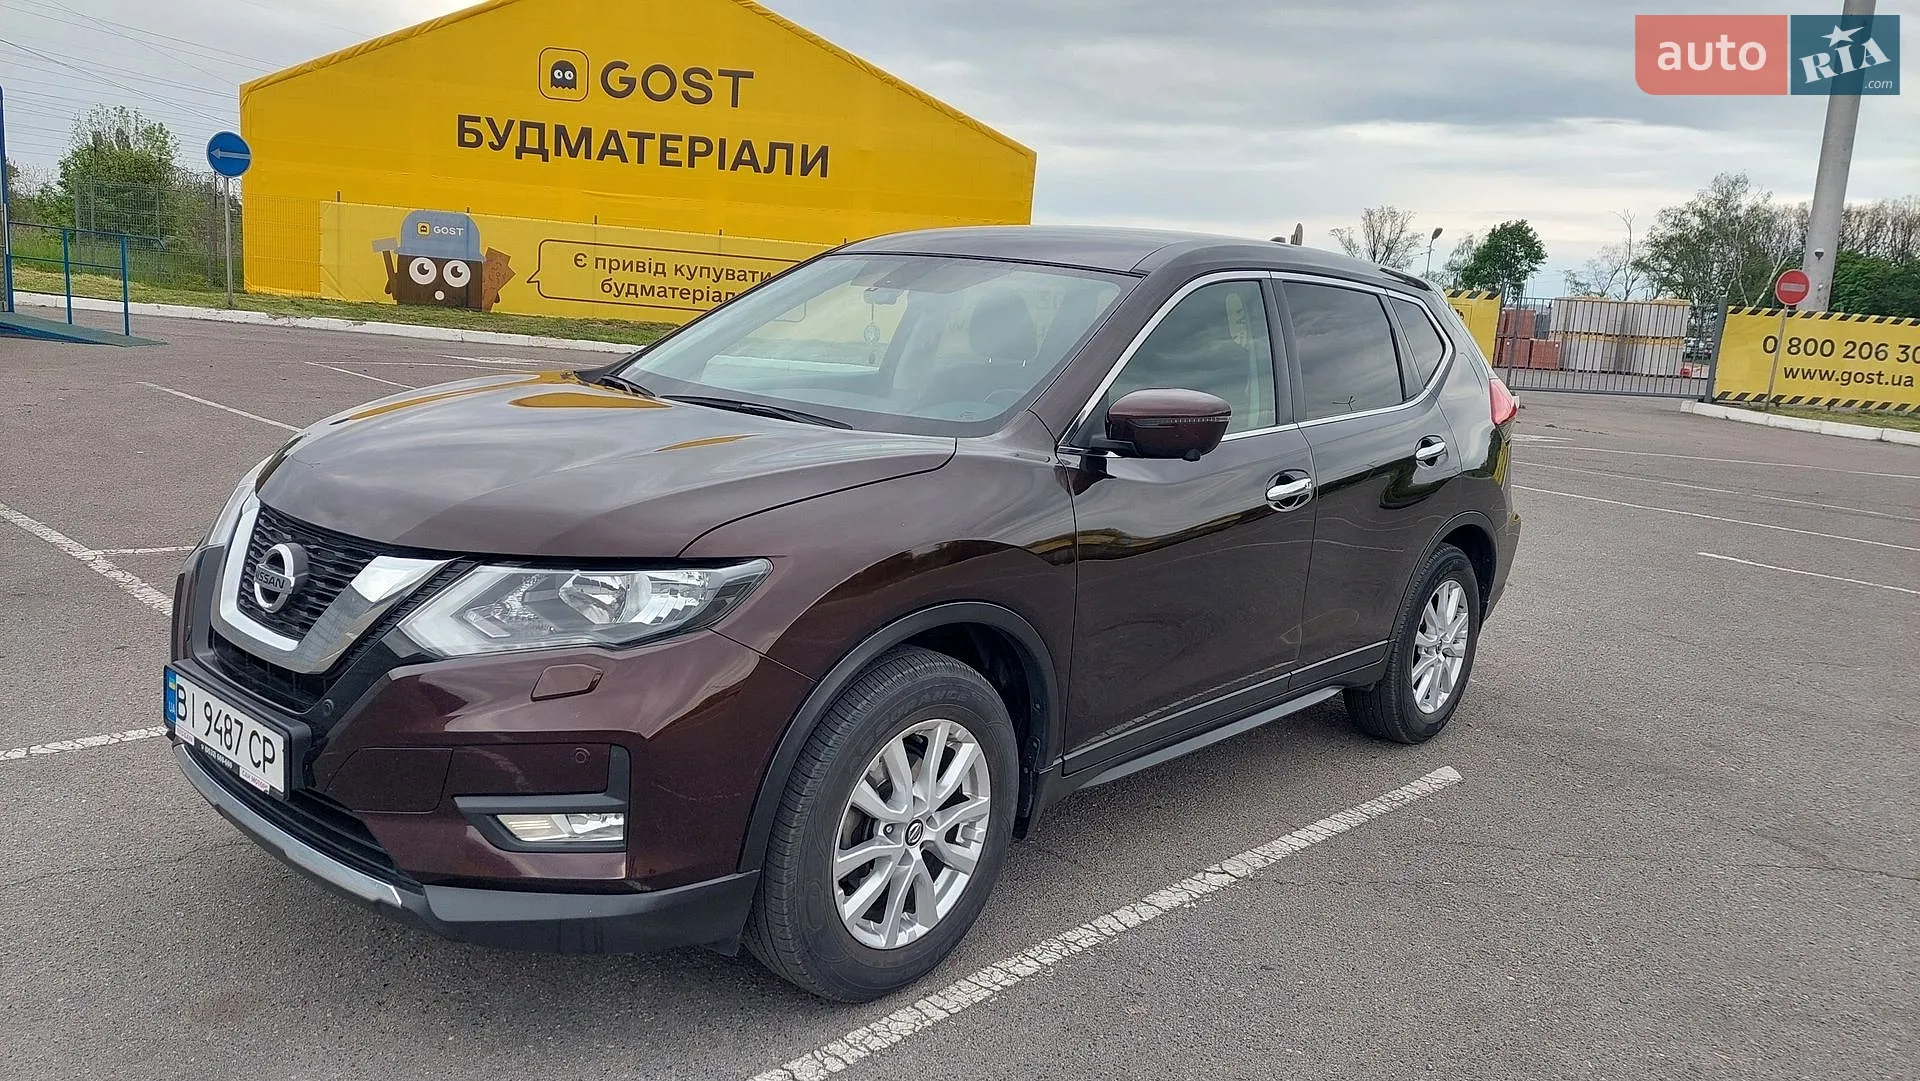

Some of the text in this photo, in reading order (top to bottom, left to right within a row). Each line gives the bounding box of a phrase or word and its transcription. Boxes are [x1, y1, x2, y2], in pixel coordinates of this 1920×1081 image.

[600, 60, 755, 108] GOST
[457, 114, 829, 178] БУДМАТЕРІАЛИ
[433, 226, 464, 236] GOST
[573, 252, 588, 268] Є
[594, 257, 667, 277] привід
[1763, 335, 1778, 354] 0
[1787, 337, 1835, 357] 800
[1843, 340, 1889, 361] 206
[1784, 366, 1914, 387] www.gost.ua
[177, 683, 195, 728] BI
[204, 701, 244, 755] 9487
[249, 730, 276, 774] CP
